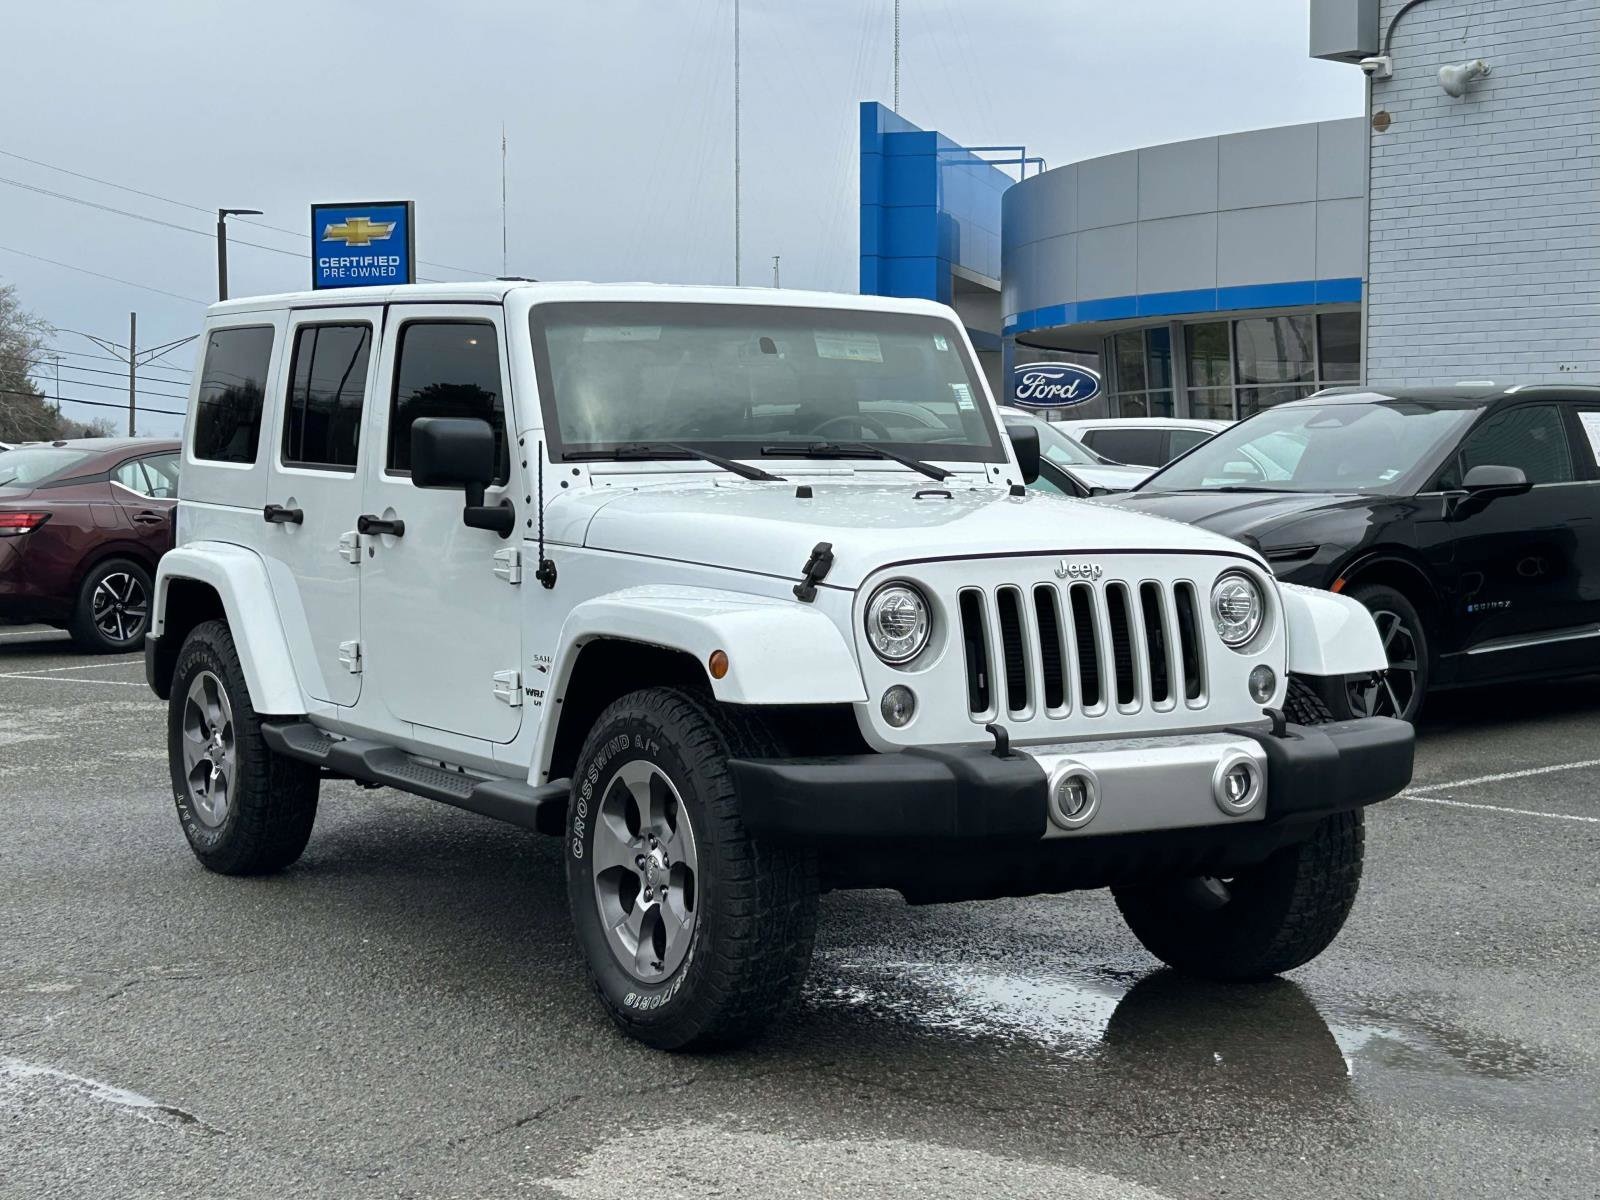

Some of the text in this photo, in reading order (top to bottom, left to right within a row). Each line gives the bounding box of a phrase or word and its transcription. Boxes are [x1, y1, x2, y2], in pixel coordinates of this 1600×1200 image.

[319, 256, 400, 267] CERTIFIED
[323, 267, 396, 278] PRE-OWNED
[1016, 372, 1080, 398] Ford
[1054, 560, 1102, 581] Jeep
[573, 734, 660, 859] CROSSWIND A/T
